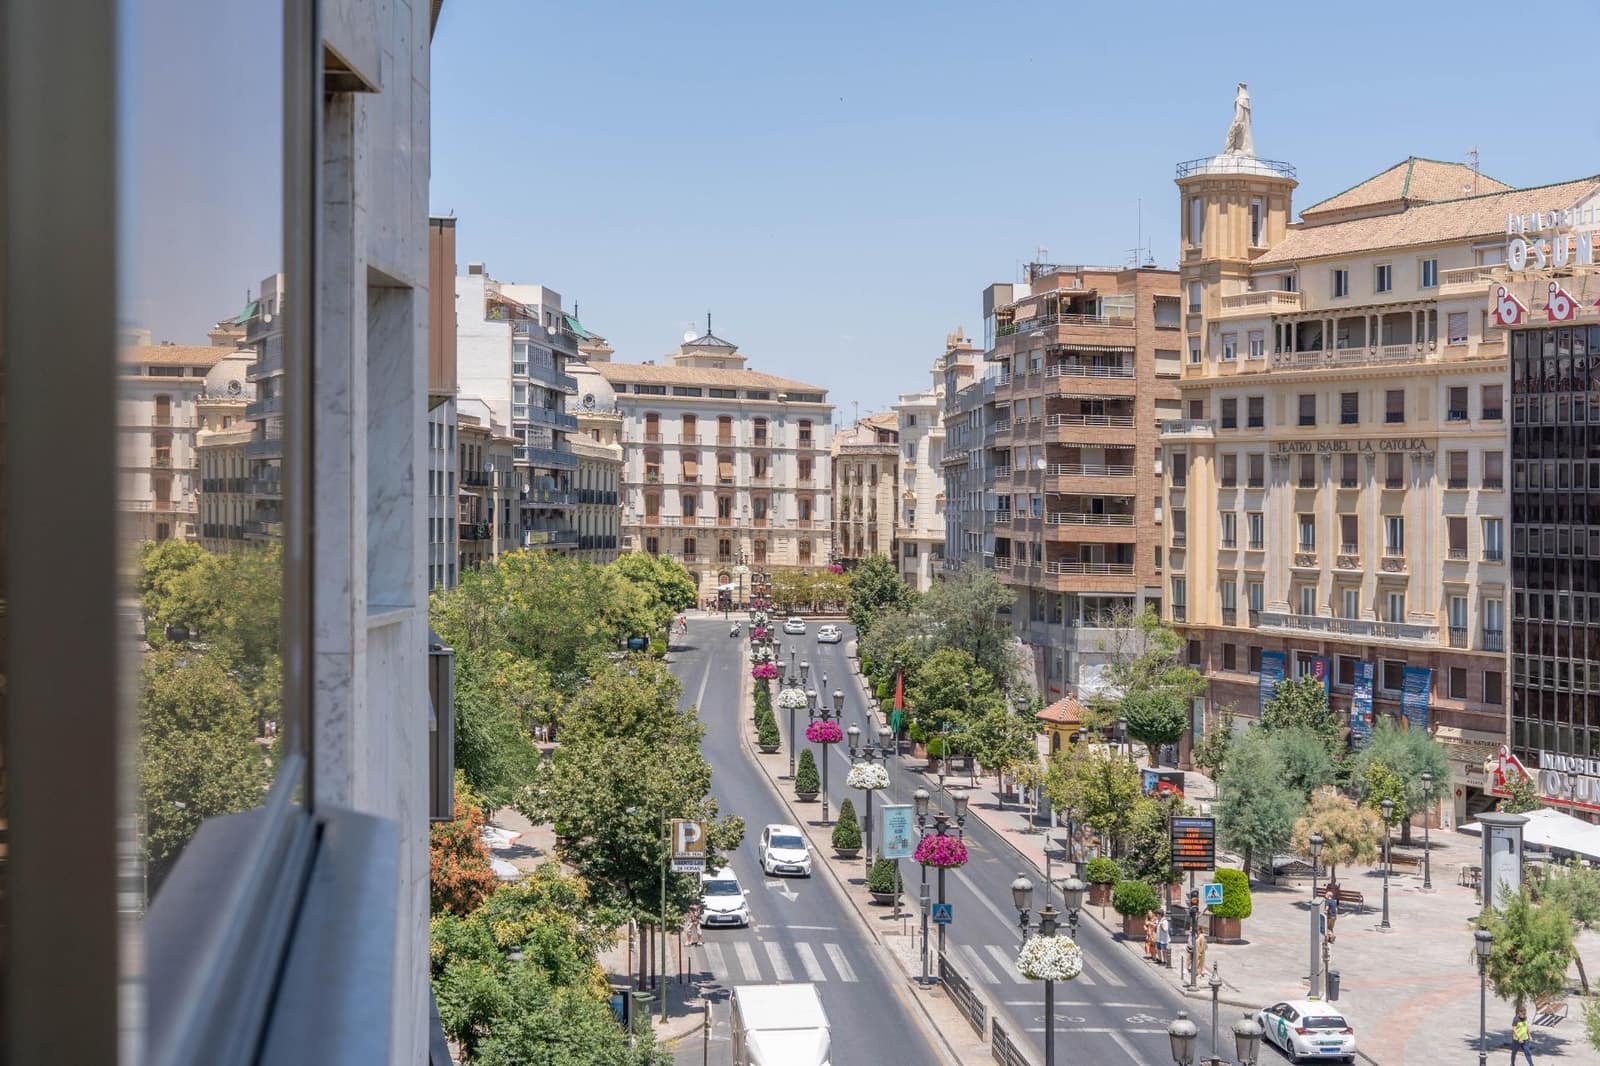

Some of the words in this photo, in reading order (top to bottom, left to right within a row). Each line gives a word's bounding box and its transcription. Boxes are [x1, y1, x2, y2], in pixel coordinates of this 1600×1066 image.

[1277, 440, 1312, 452] TEATRO
[1317, 440, 1351, 451] ISABEL
[1358, 440, 1372, 450] LA
[678, 822, 702, 853] P
